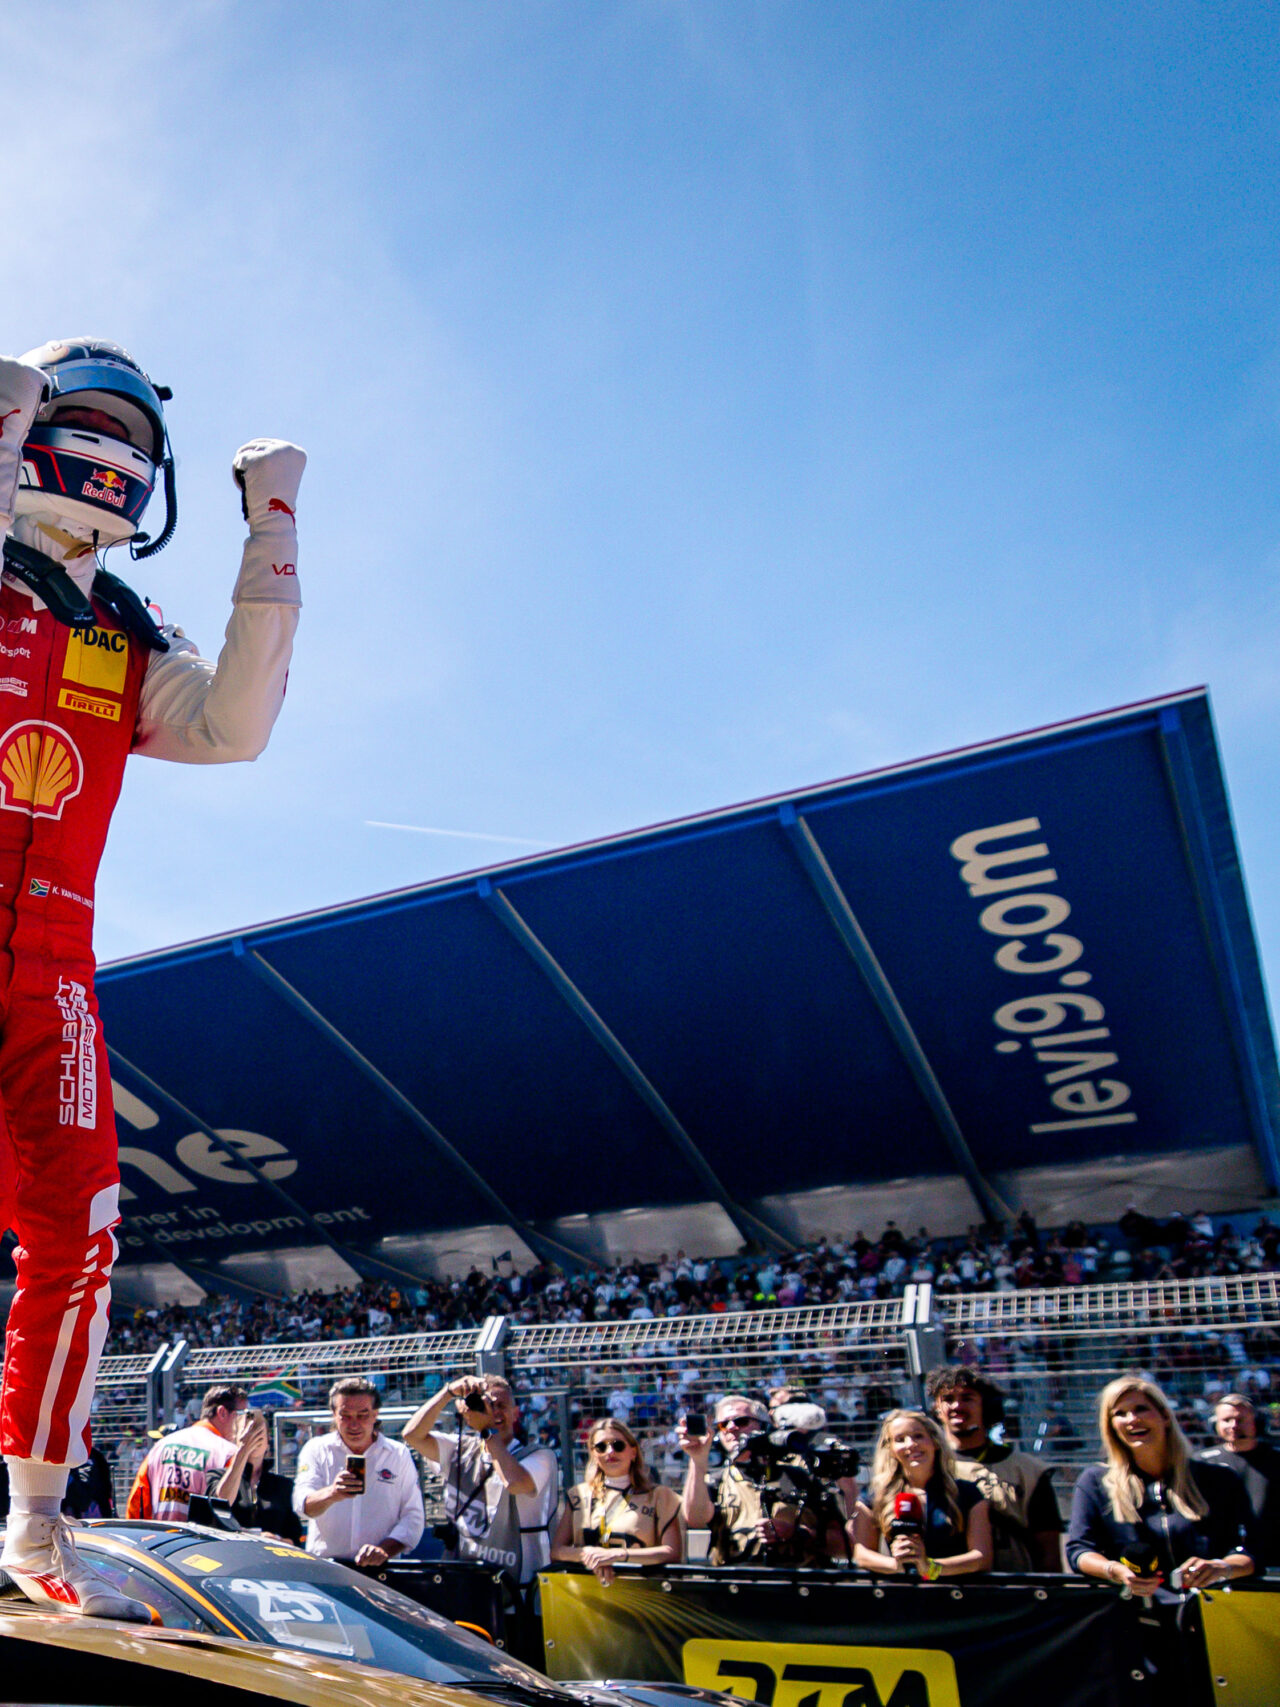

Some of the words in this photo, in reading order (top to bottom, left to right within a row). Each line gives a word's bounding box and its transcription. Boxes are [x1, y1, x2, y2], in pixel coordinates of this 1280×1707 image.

[82, 482, 105, 501] Red
[105, 490, 127, 508] Bull
[65, 692, 117, 717] PIRELLI
[950, 816, 1138, 1134] levi9.com
[54, 975, 78, 1126] SCHUBERT
[183, 1204, 220, 1220] in
[163, 1446, 206, 1468] DEKRA
[167, 1466, 191, 1489] 233
[231, 1578, 324, 1622] 25
